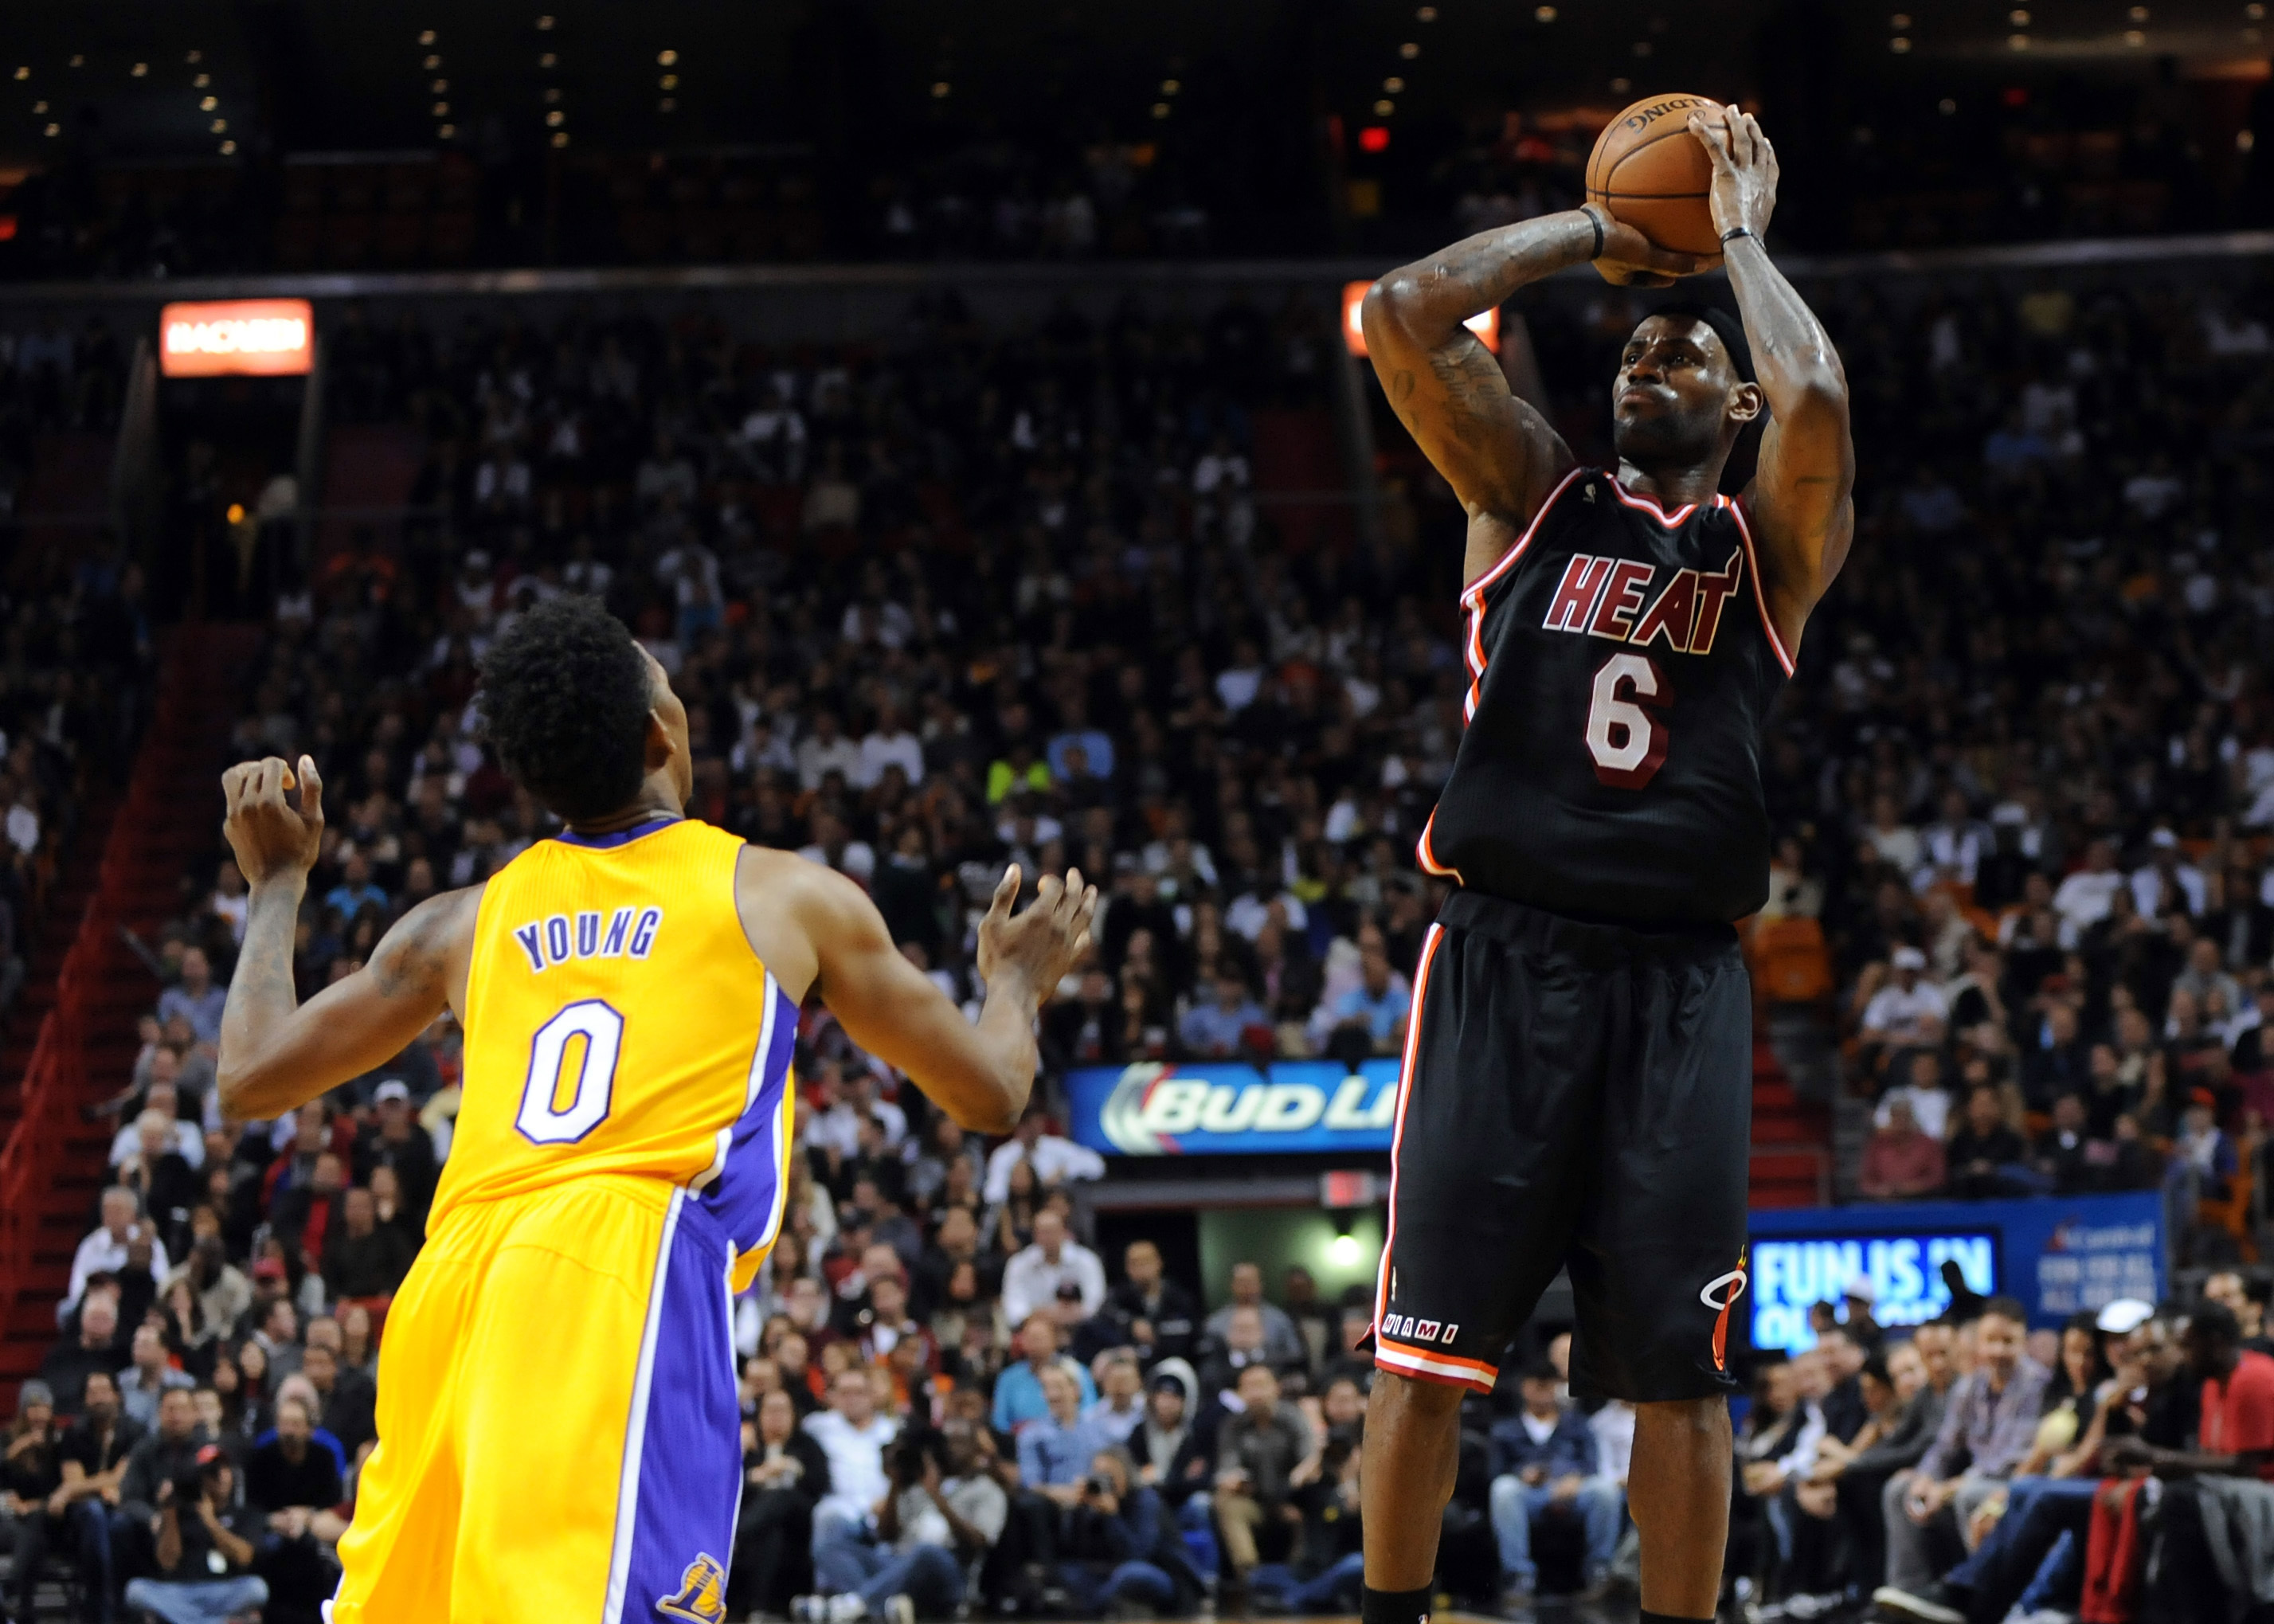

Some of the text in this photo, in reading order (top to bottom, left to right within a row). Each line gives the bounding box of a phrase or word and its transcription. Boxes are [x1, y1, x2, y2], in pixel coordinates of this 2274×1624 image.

[1626, 98, 1705, 135] LDING
[1542, 545, 1743, 655] HEAT
[1584, 652, 1671, 787] 6
[512, 905, 663, 974] YOUNG
[515, 999, 624, 1145] 0
[1754, 1241, 1862, 1306] FUN
[1869, 1238, 1924, 1301] IS
[1381, 1313, 1459, 1344] MIAMI
